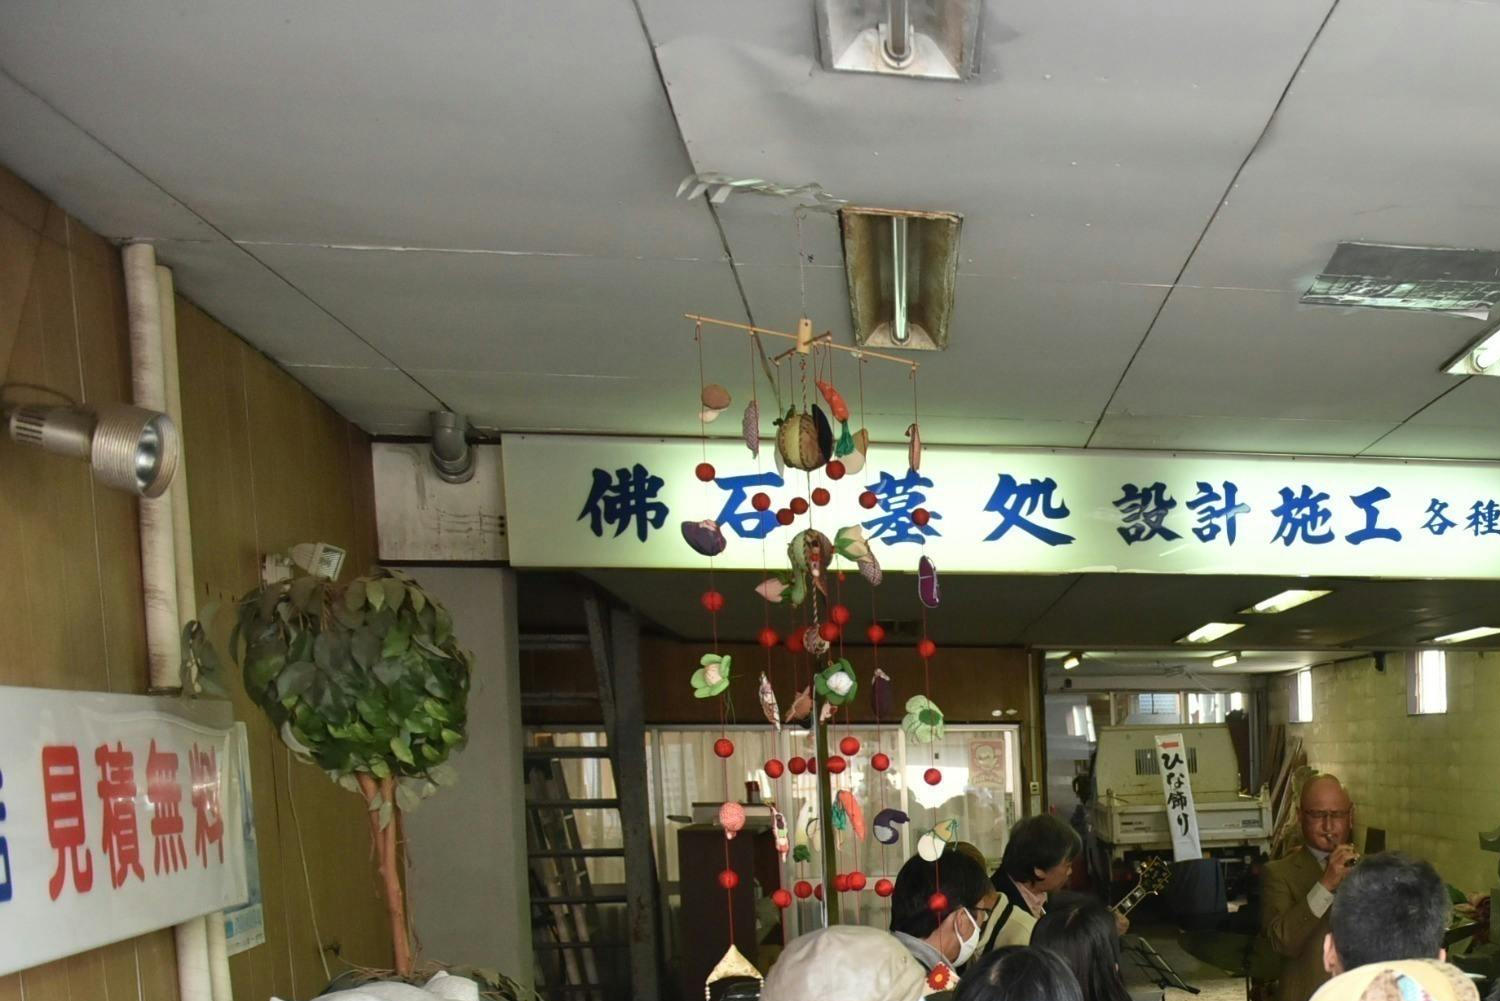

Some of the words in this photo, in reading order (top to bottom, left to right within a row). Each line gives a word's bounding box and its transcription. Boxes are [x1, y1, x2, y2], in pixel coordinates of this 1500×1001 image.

[41, 738, 224, 901] 見積無料
[1161, 753, 1189, 836] ひな飾り
